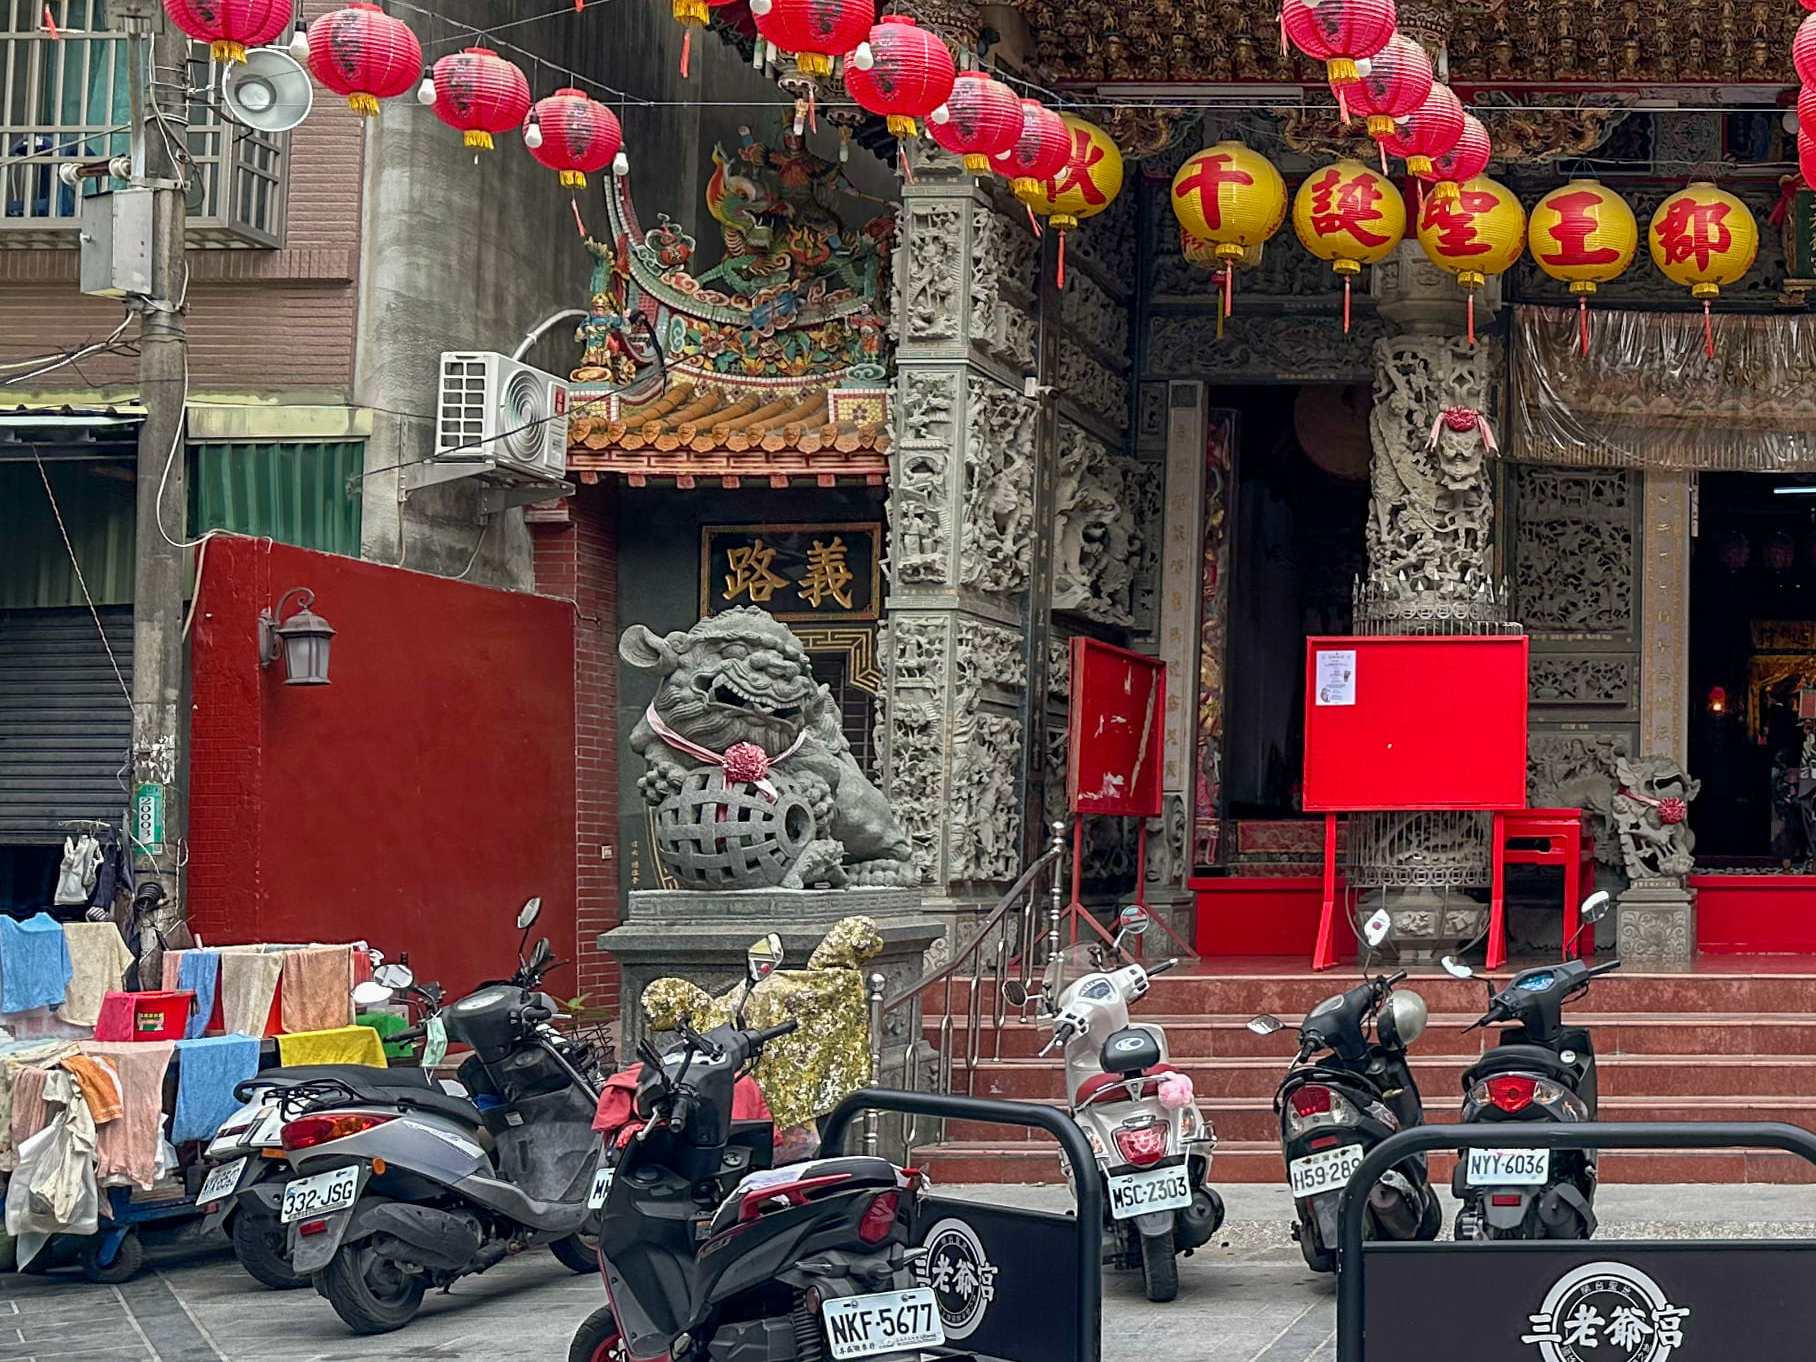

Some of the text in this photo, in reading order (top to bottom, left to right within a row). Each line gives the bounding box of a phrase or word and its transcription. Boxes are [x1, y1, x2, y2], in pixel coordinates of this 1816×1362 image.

[1176, 153, 1253, 230] 千
[1311, 170, 1390, 247] 誕
[1423, 185, 1499, 256] 聖
[1540, 191, 1620, 265] 王
[1655, 198, 1731, 272] 郡
[722, 536, 854, 609] 義路
[284, 1180, 353, 1215] 332-JSG
[1113, 1177, 1187, 1209] MSC-2303
[1471, 1155, 1544, 1175] NYY-6036
[830, 1303, 932, 1344] NKF-5677
[1521, 1303, 1690, 1352] 三老爺宮
